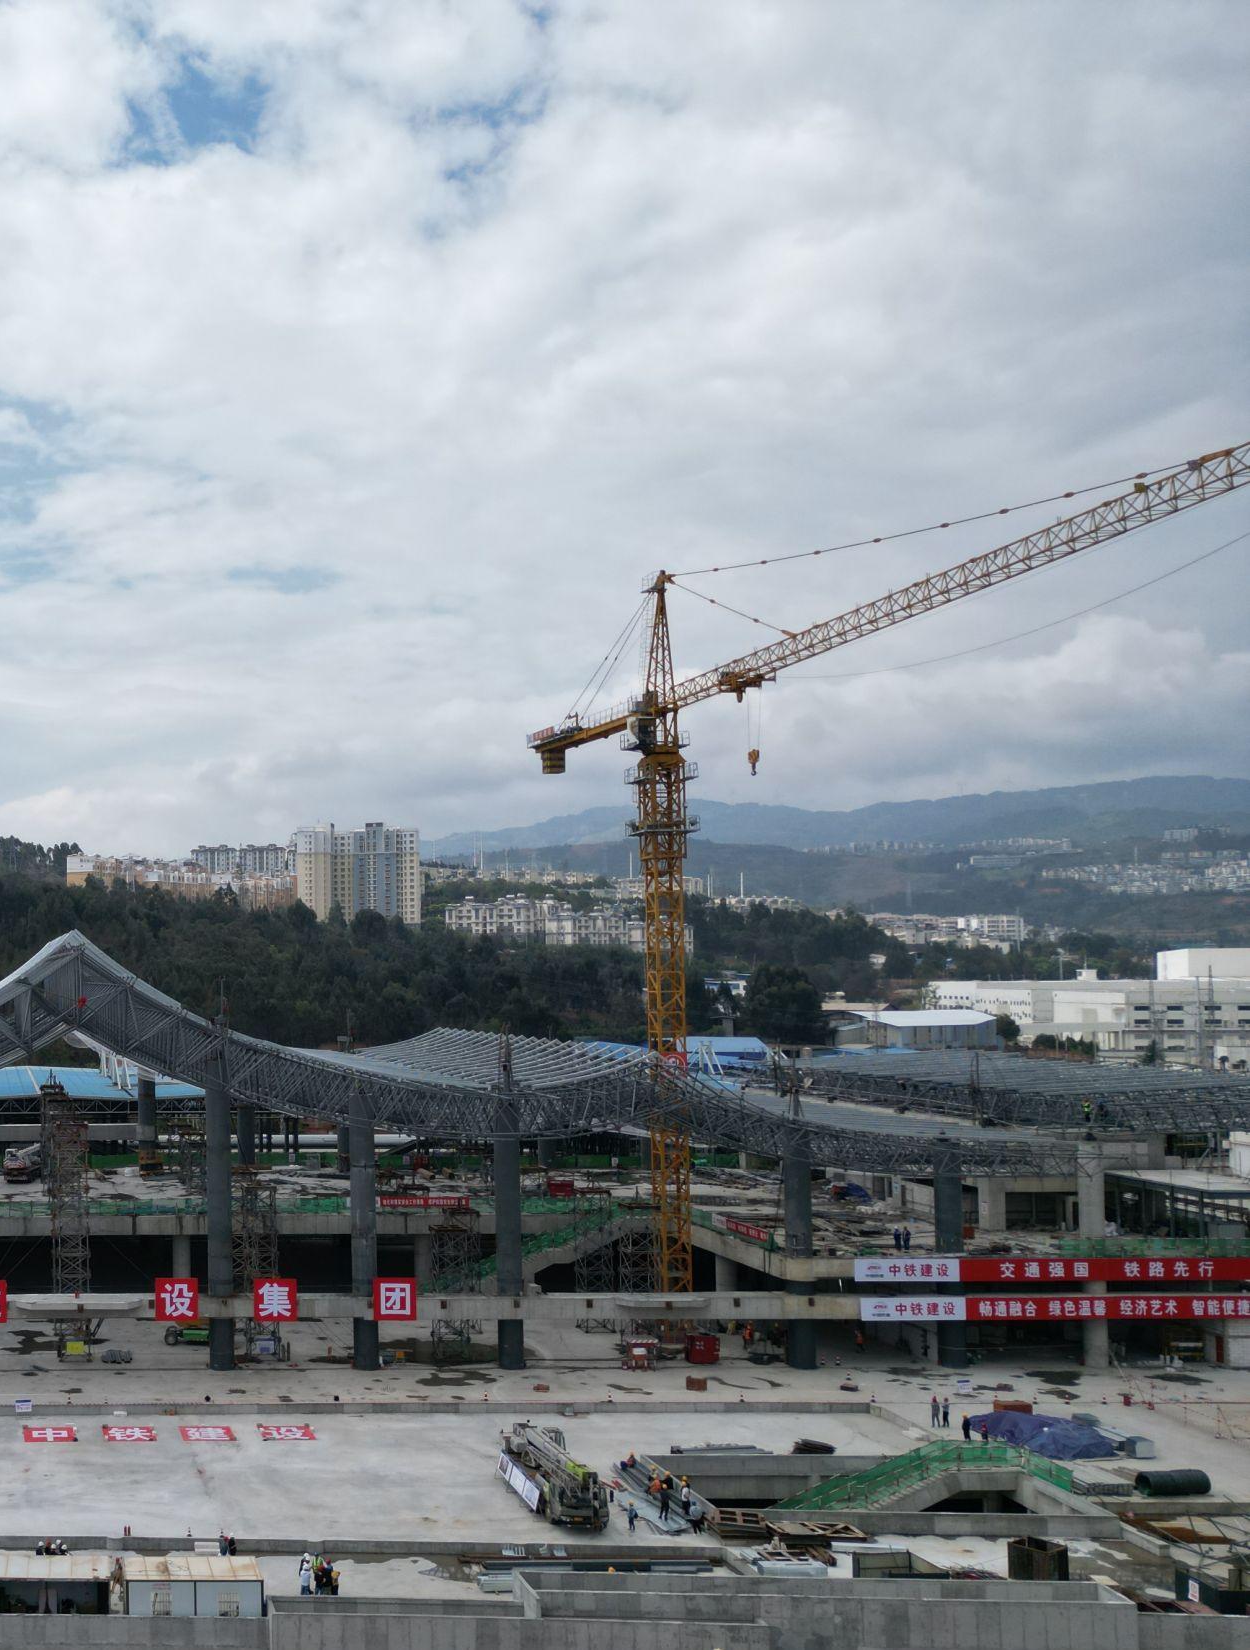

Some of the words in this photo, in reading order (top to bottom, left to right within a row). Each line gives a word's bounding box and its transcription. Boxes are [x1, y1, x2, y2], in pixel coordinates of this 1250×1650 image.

[889, 1264, 949, 1277] 中铁建设
[1000, 1262, 1089, 1278] 交通强国
[1124, 1261, 1214, 1277] 铁路先行
[895, 1303, 956, 1316] 中铁建设
[979, 1301, 1037, 1317] 畅通融合
[1048, 1300, 1107, 1317] 绿色温馨
[1119, 1300, 1178, 1316] 经济艺术
[1192, 1299, 1250, 1316] 智能便捷
